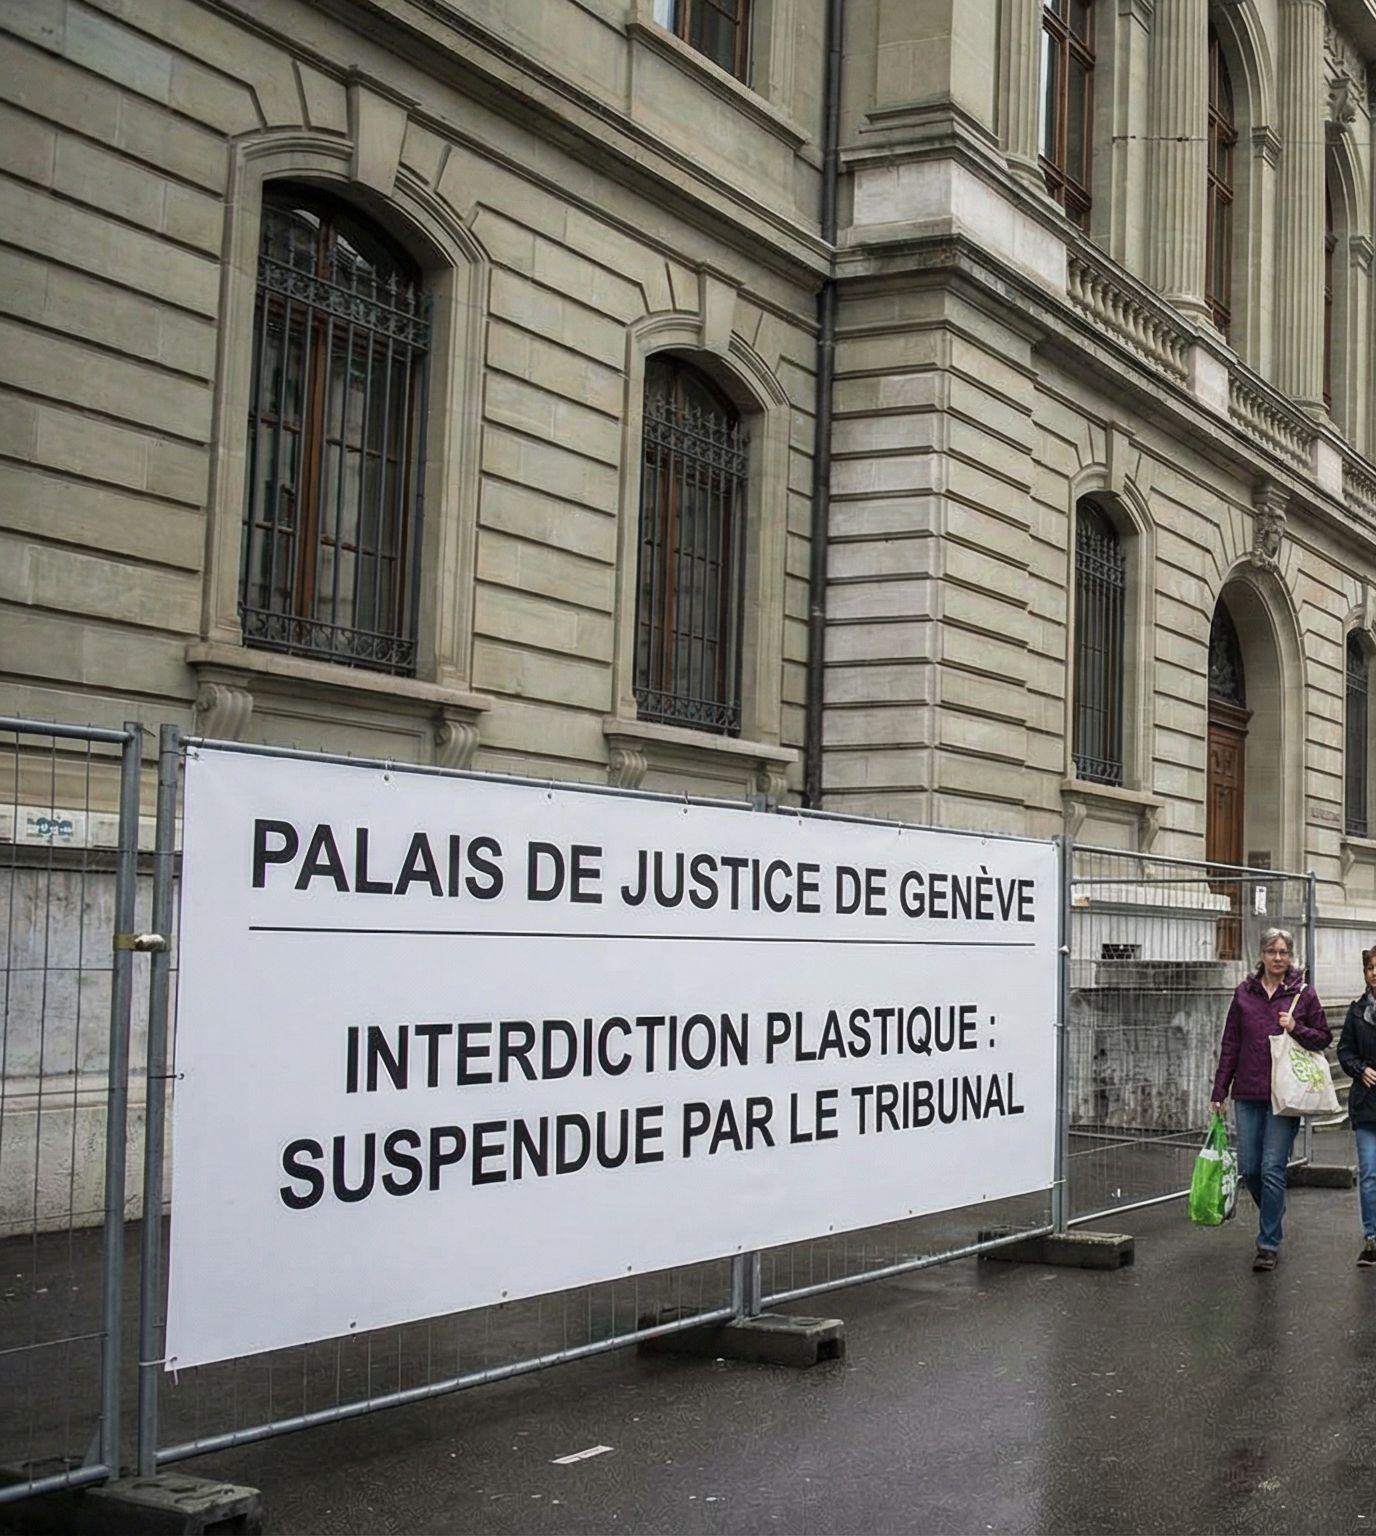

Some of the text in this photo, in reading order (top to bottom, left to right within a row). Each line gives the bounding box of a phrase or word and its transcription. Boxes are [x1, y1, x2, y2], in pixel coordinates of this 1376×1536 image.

[252, 818, 1036, 923] PALAIS DE JUSTICE DE GENÈVE
[346, 1004, 996, 1094] INTERDICTION PLASTIQUE :
[279, 1072, 1026, 1210] SUSPENDUE PAR LE TRIBUNAL
